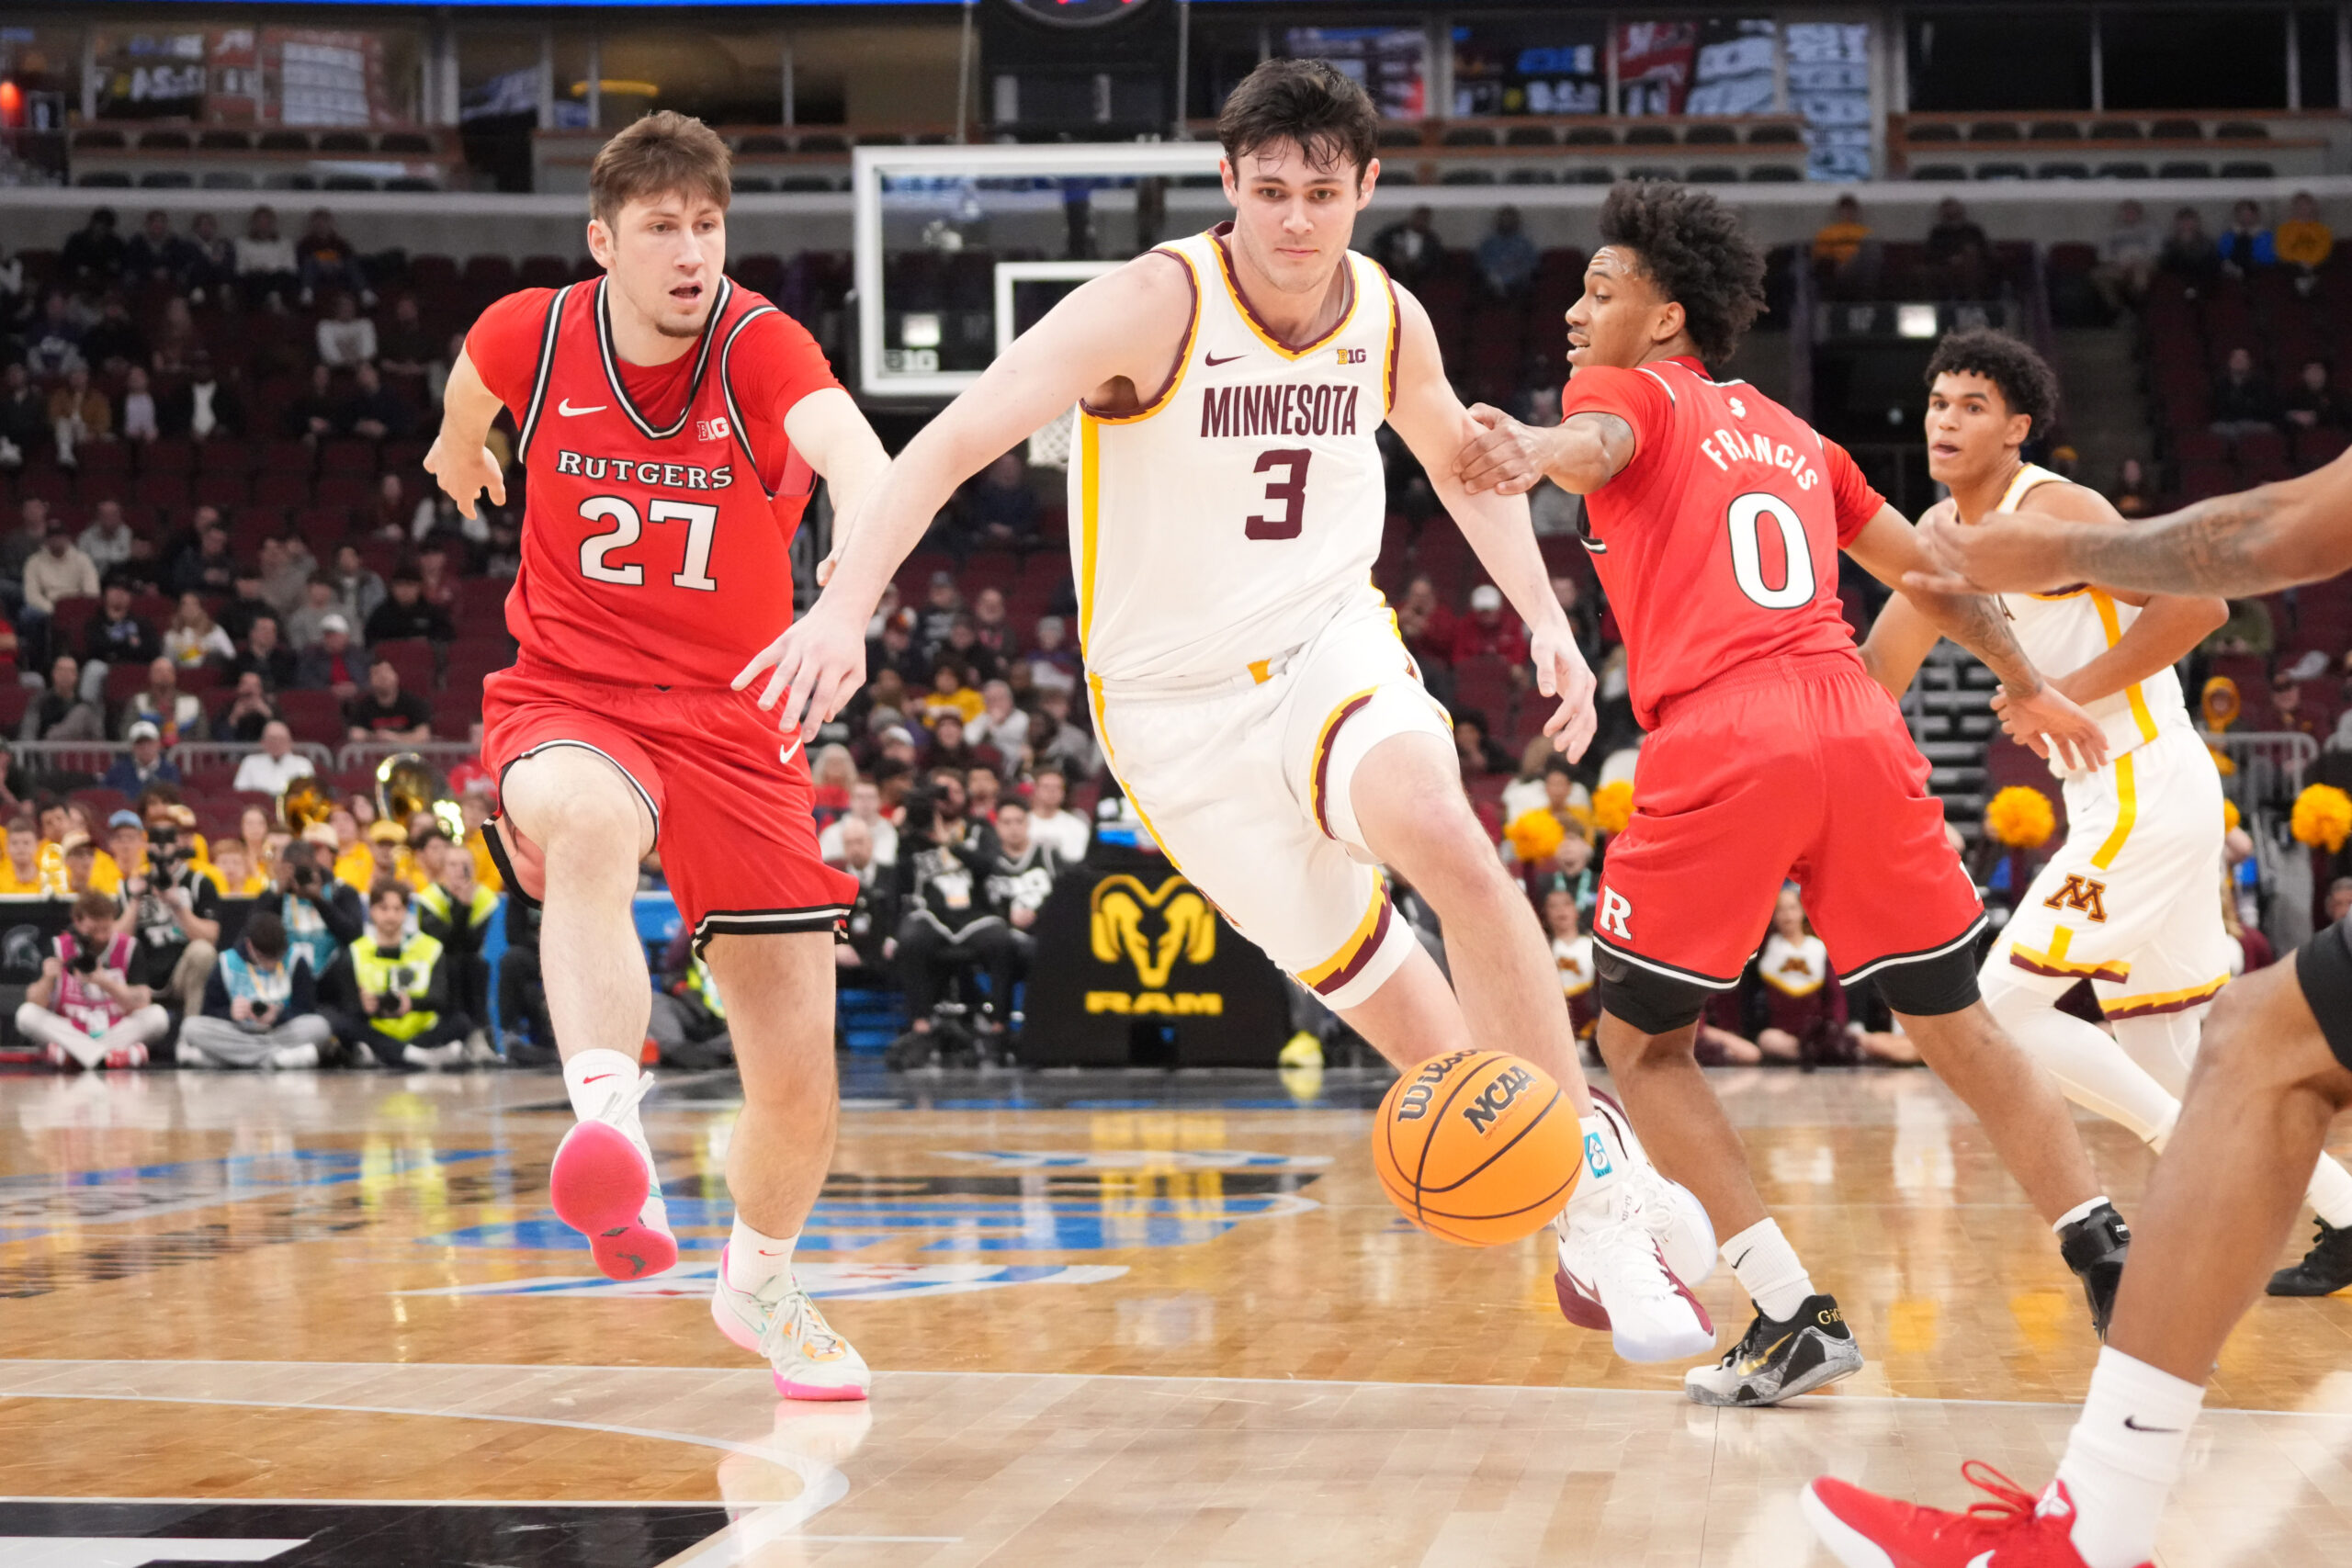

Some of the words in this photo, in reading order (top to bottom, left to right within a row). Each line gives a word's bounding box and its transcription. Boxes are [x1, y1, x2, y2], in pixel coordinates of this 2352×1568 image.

[1200, 384, 1359, 437] MINNESOTA
[556, 449, 734, 491] RUTGERS
[1701, 428, 1818, 491] FRANCIS
[1244, 447, 1313, 540] 3
[578, 493, 719, 592] 27
[1726, 491, 1816, 611] 0
[1599, 885, 1634, 941] R
[2042, 873, 2109, 924] M
[1084, 990, 1224, 1017] RAM
[1396, 1049, 1481, 1122] Wilso
[1463, 1065, 1537, 1135] NCAA
